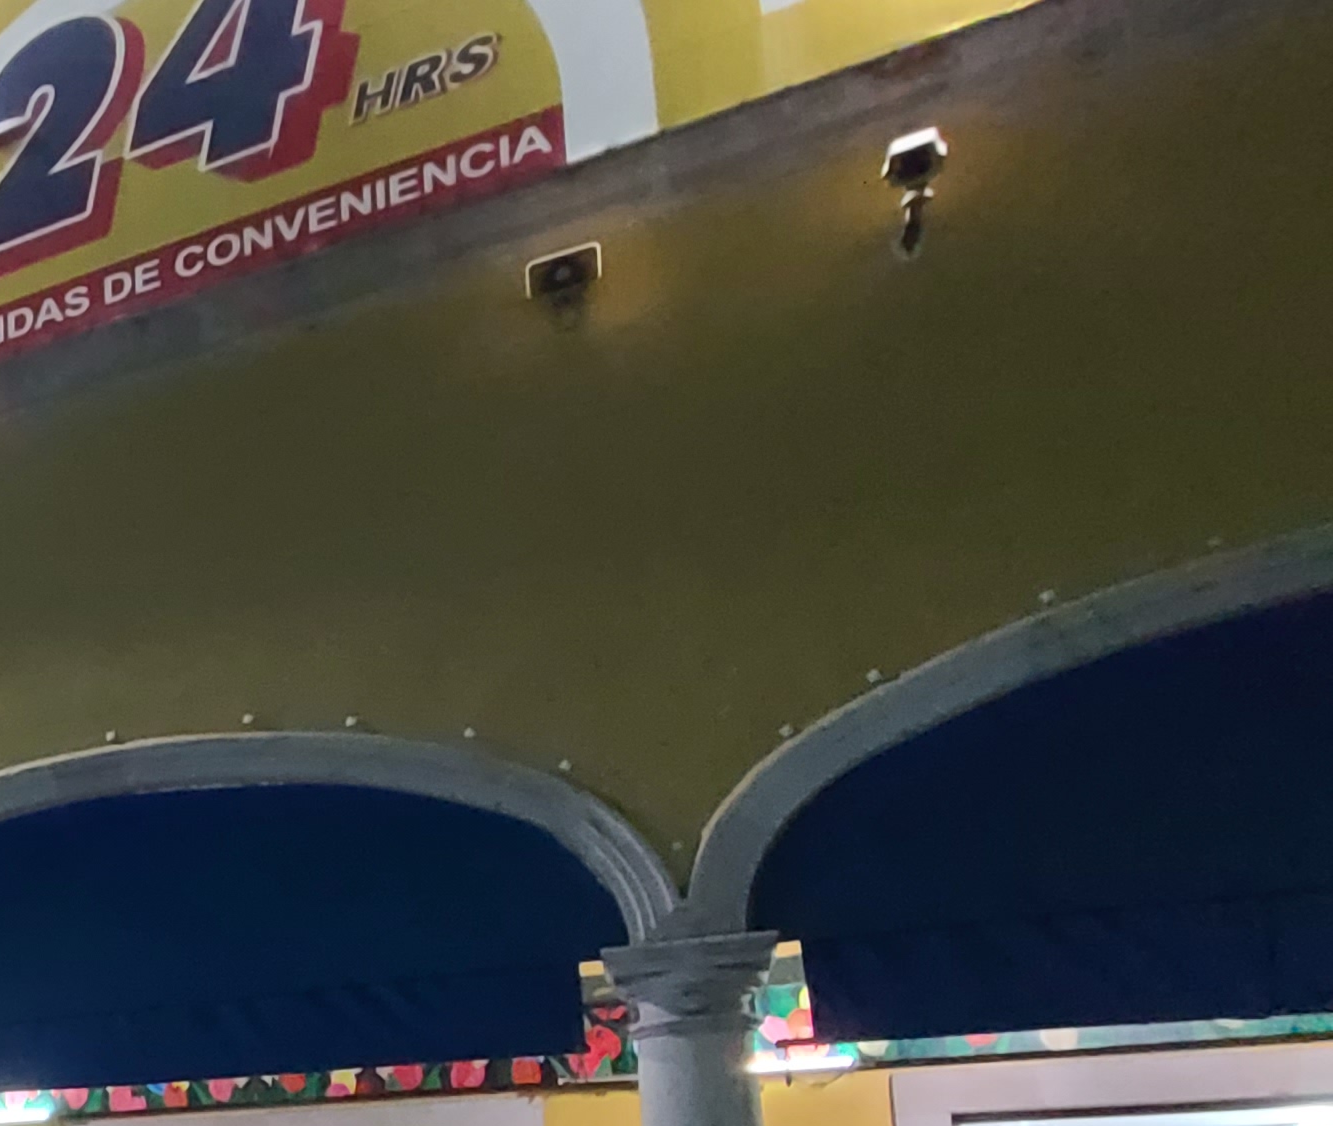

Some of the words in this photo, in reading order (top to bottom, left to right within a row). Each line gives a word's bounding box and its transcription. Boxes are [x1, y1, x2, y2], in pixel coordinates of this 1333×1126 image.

[350, 32, 503, 126] HRS
[103, 258, 162, 305] DE
[173, 125, 552, 279] CONVENIENCIA
